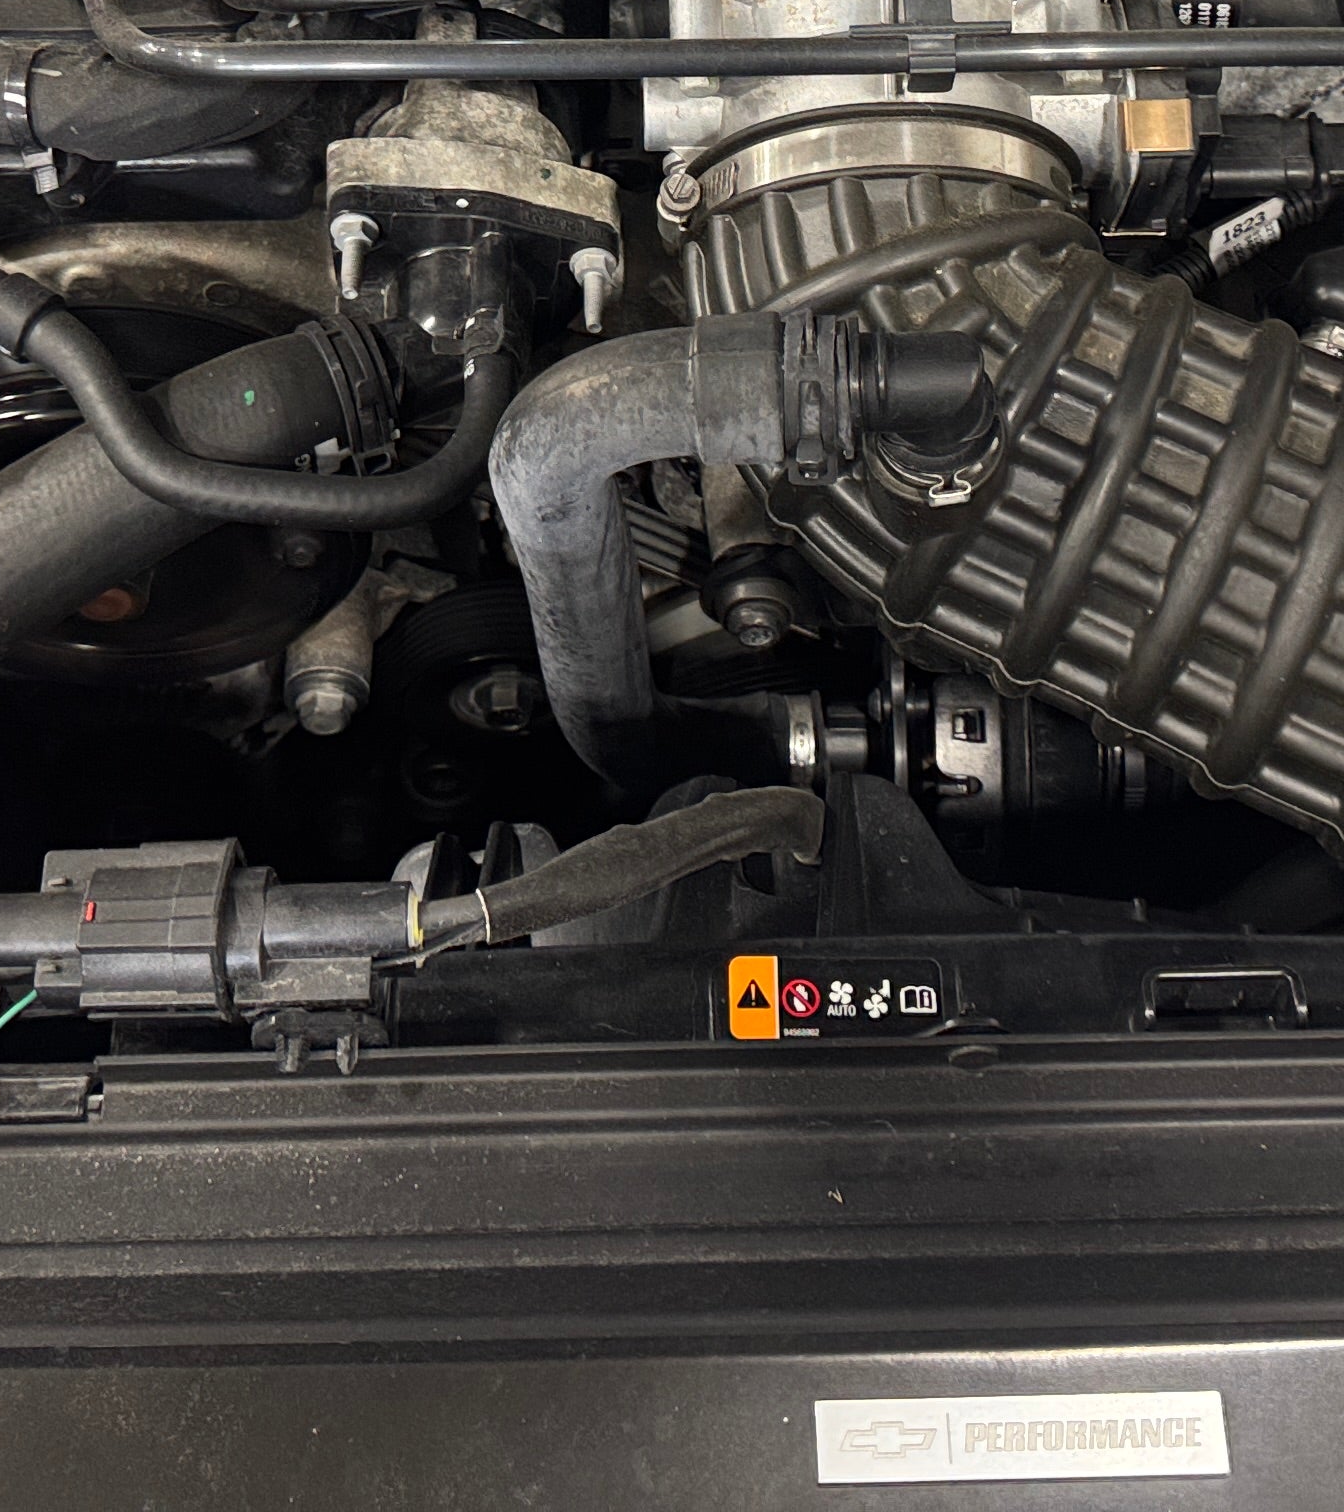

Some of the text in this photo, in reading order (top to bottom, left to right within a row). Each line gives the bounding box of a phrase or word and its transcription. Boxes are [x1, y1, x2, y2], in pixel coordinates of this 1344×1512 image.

[1222, 211, 1265, 244] 1823
[826, 1004, 856, 1017] AUTO
[964, 1417, 1202, 1453] PERFORMANCE
